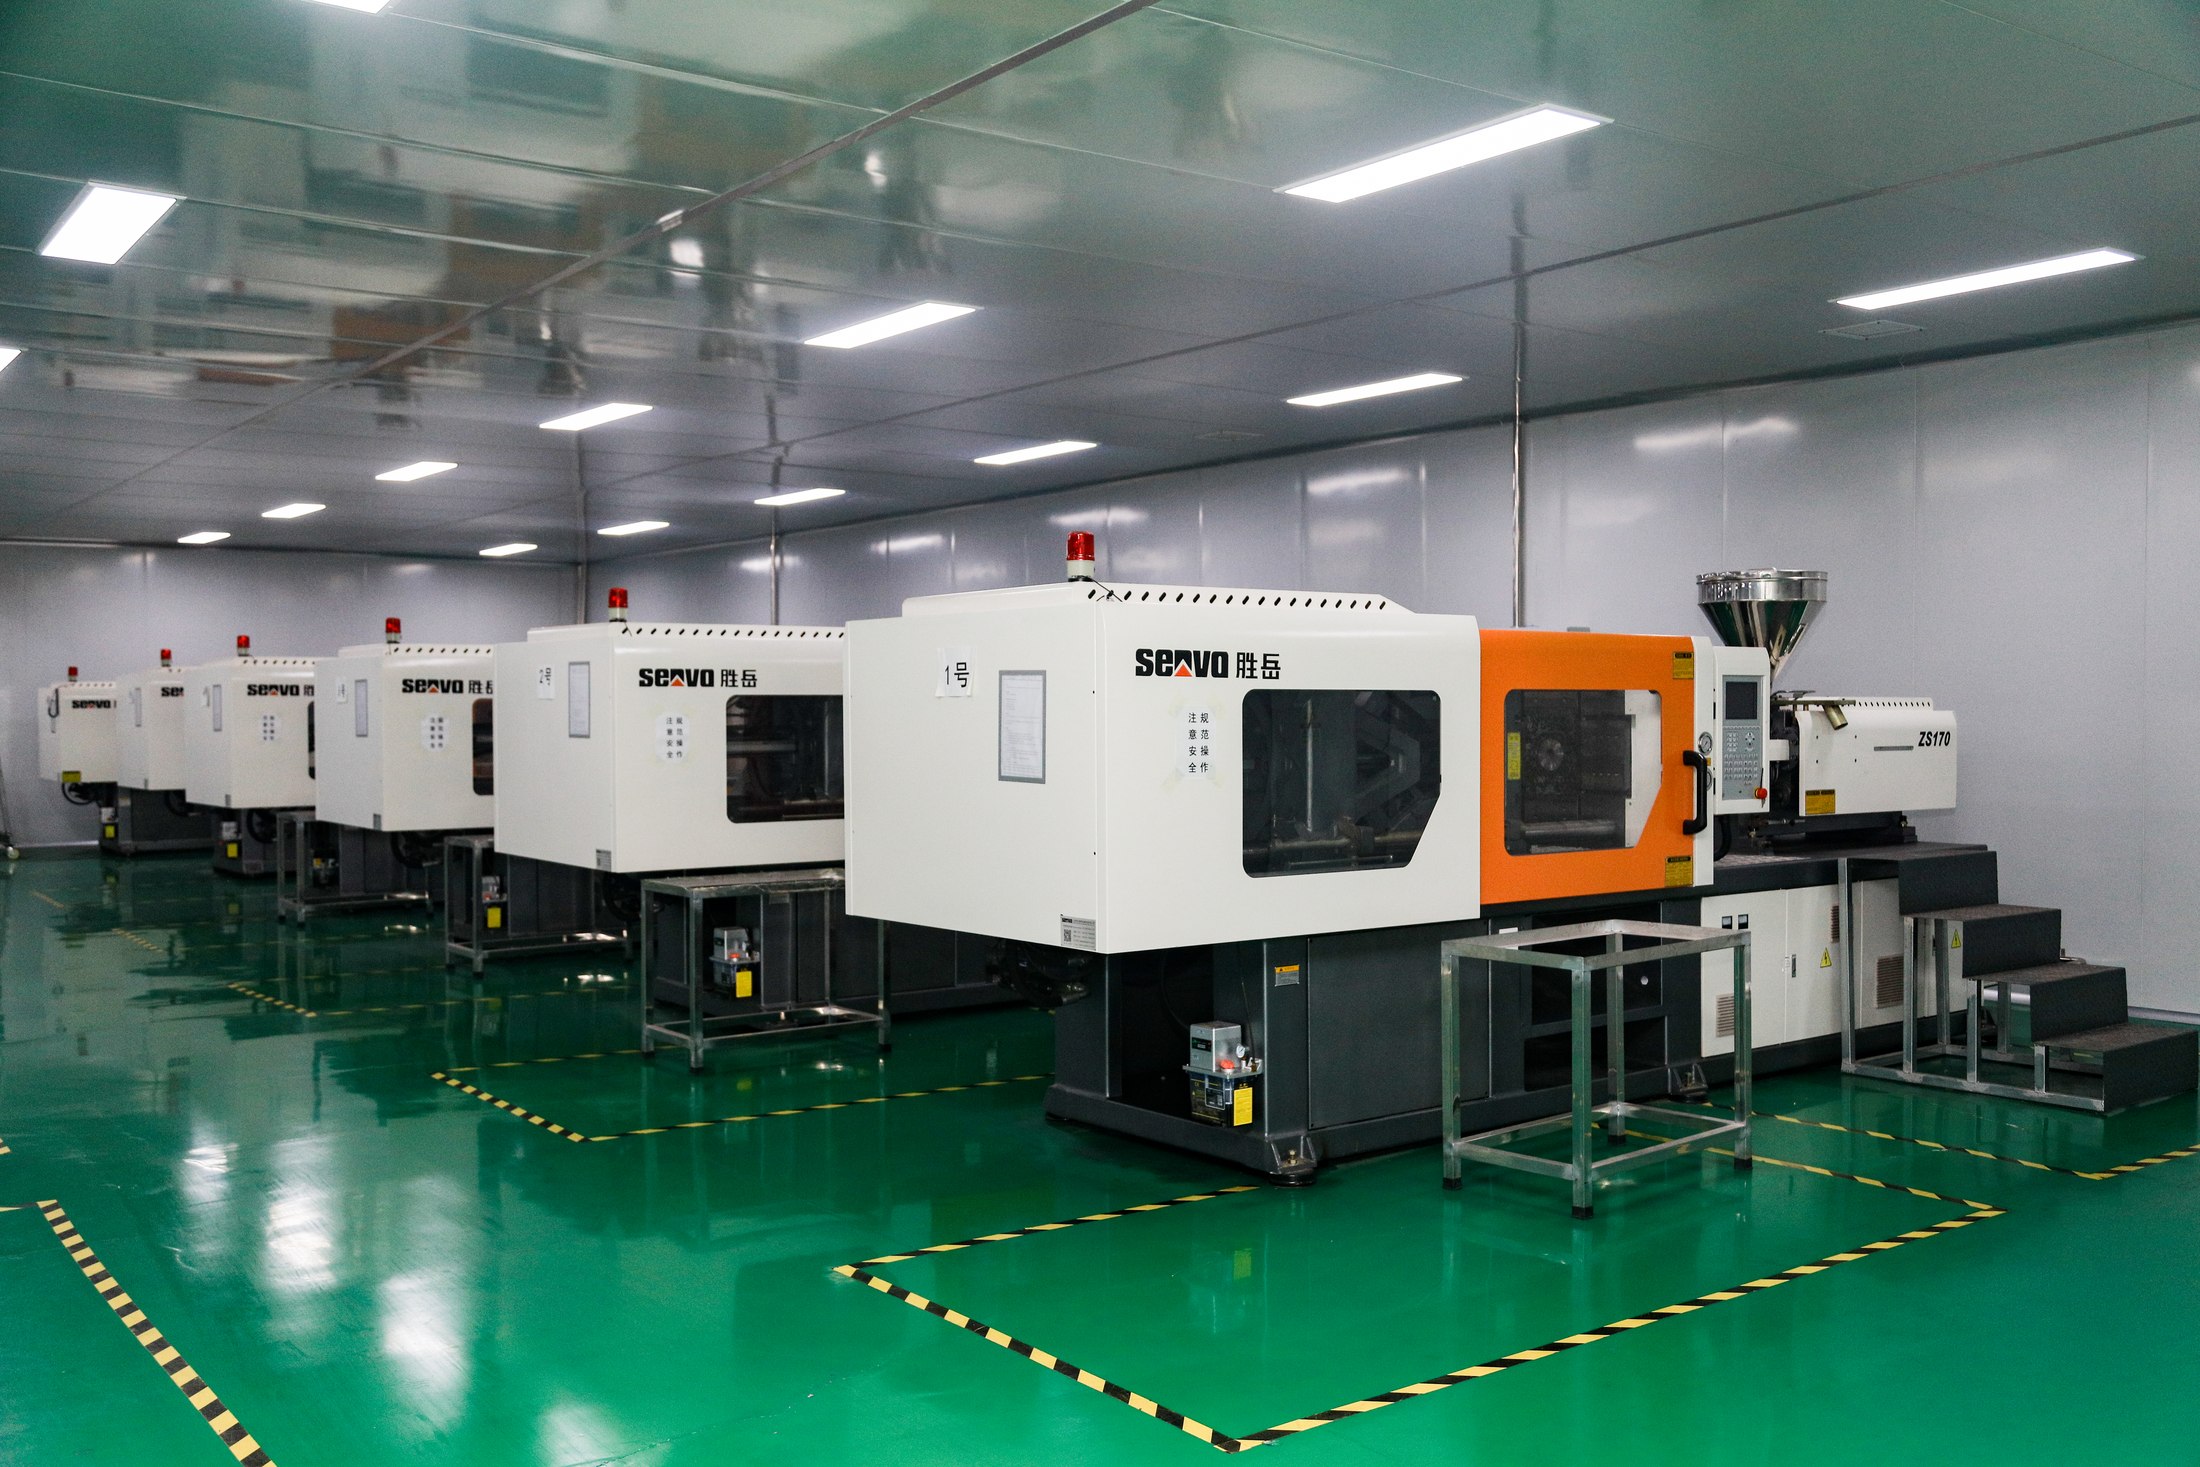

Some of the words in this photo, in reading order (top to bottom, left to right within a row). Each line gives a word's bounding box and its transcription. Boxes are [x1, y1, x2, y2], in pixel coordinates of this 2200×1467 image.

[944, 661, 970, 688] 1号
[1236, 652, 1281, 679] 胜岳
[720, 669, 758, 688] 胜岳
[1918, 731, 1951, 747] ZS170
